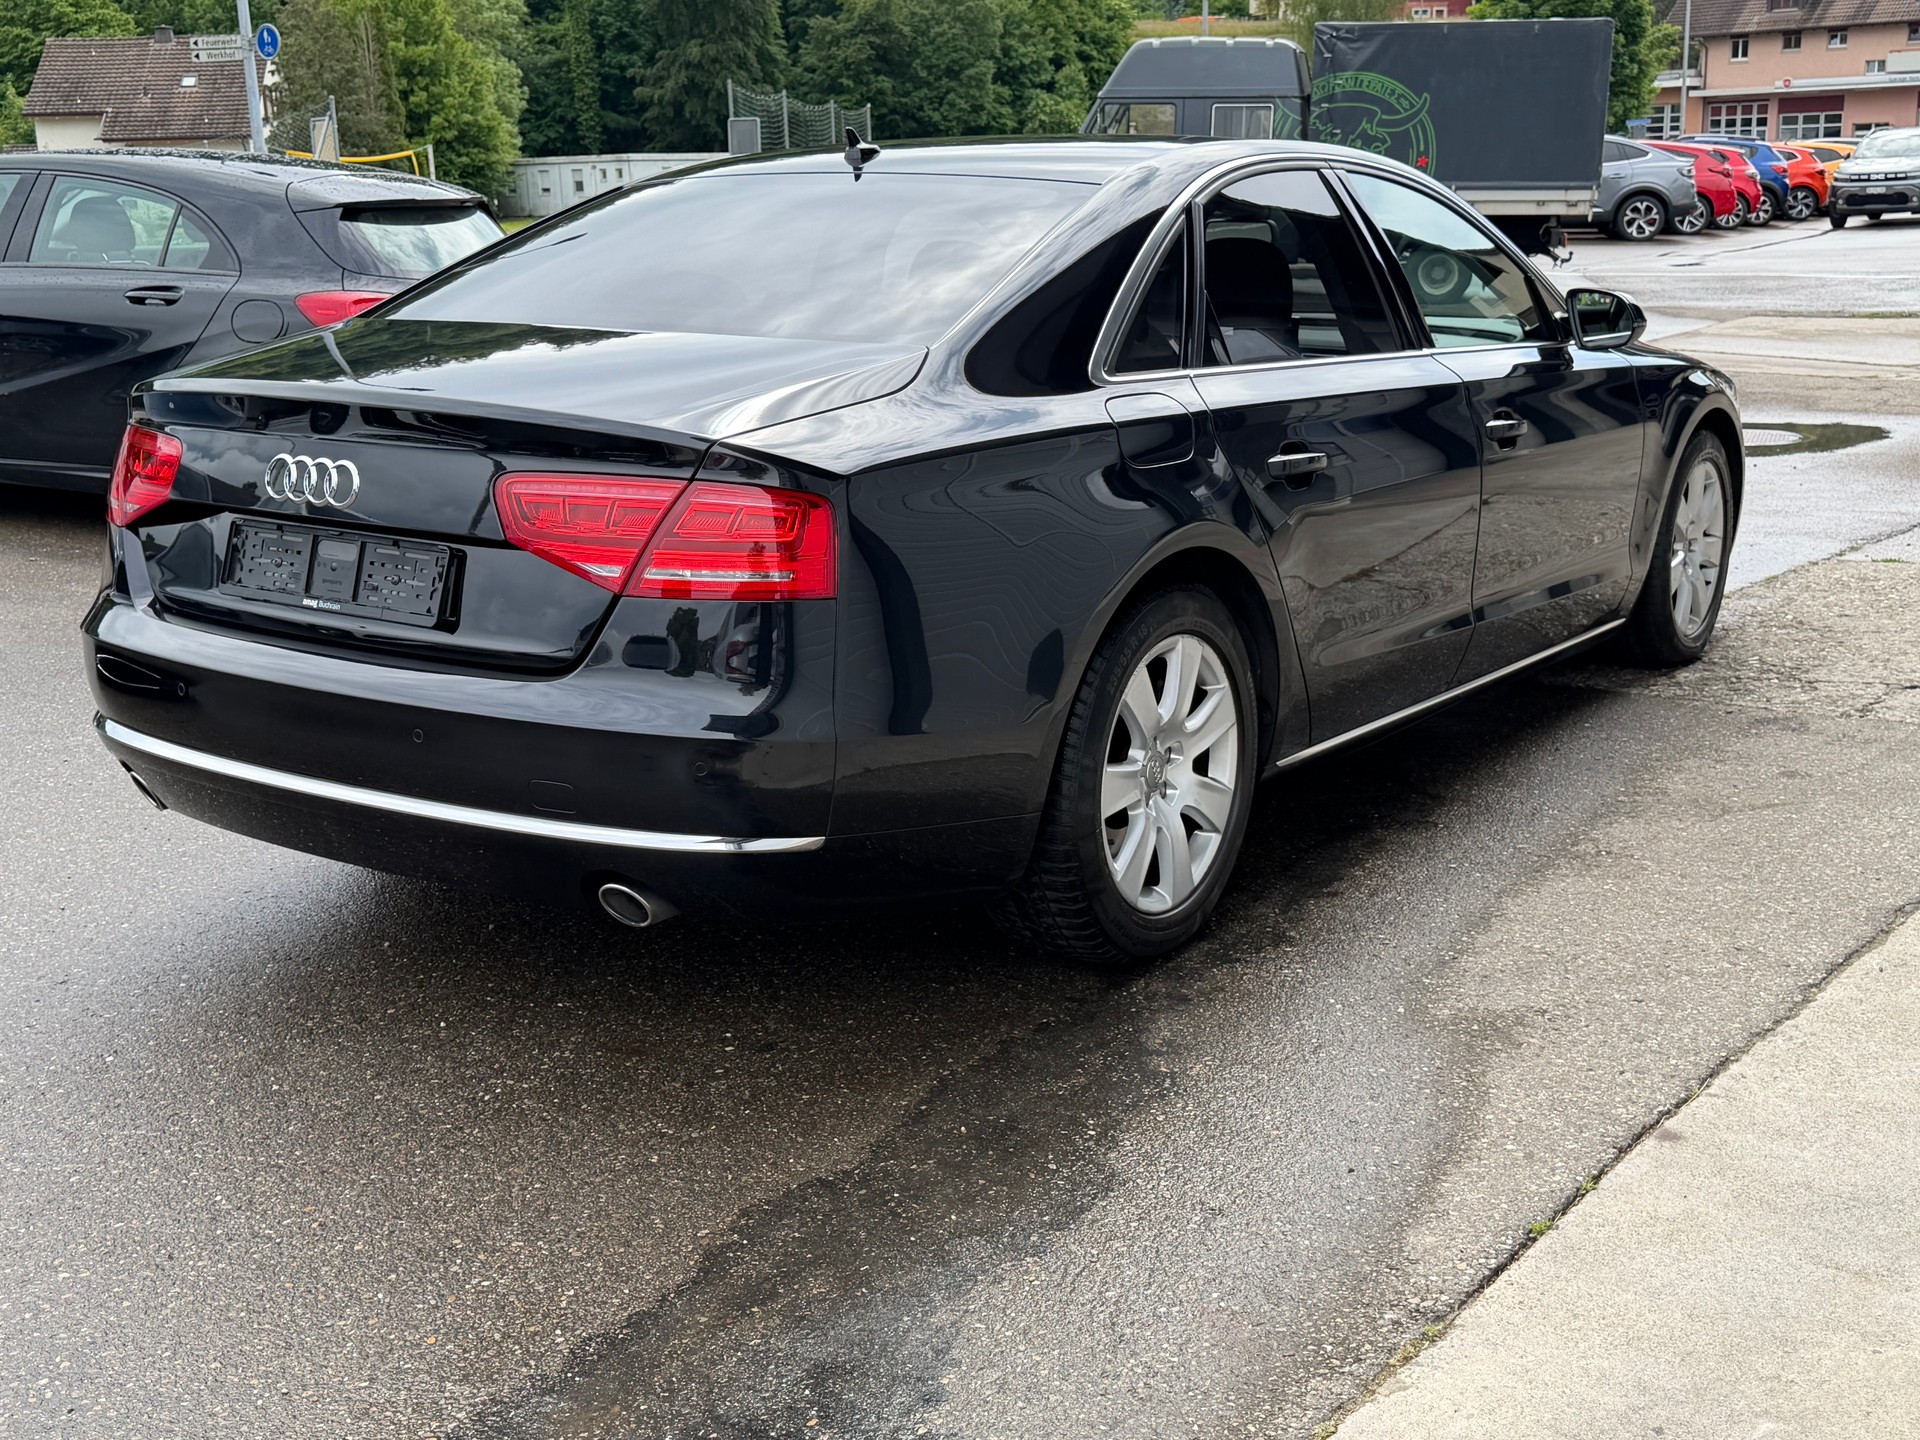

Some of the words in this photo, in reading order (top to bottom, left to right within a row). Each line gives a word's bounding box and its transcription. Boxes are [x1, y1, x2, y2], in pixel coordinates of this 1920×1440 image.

[201, 38, 238, 46] Feuerwehr
[206, 51, 236, 60] Werkhof
[302, 598, 318, 608] amag
[318, 600, 341, 610] Buchrain
